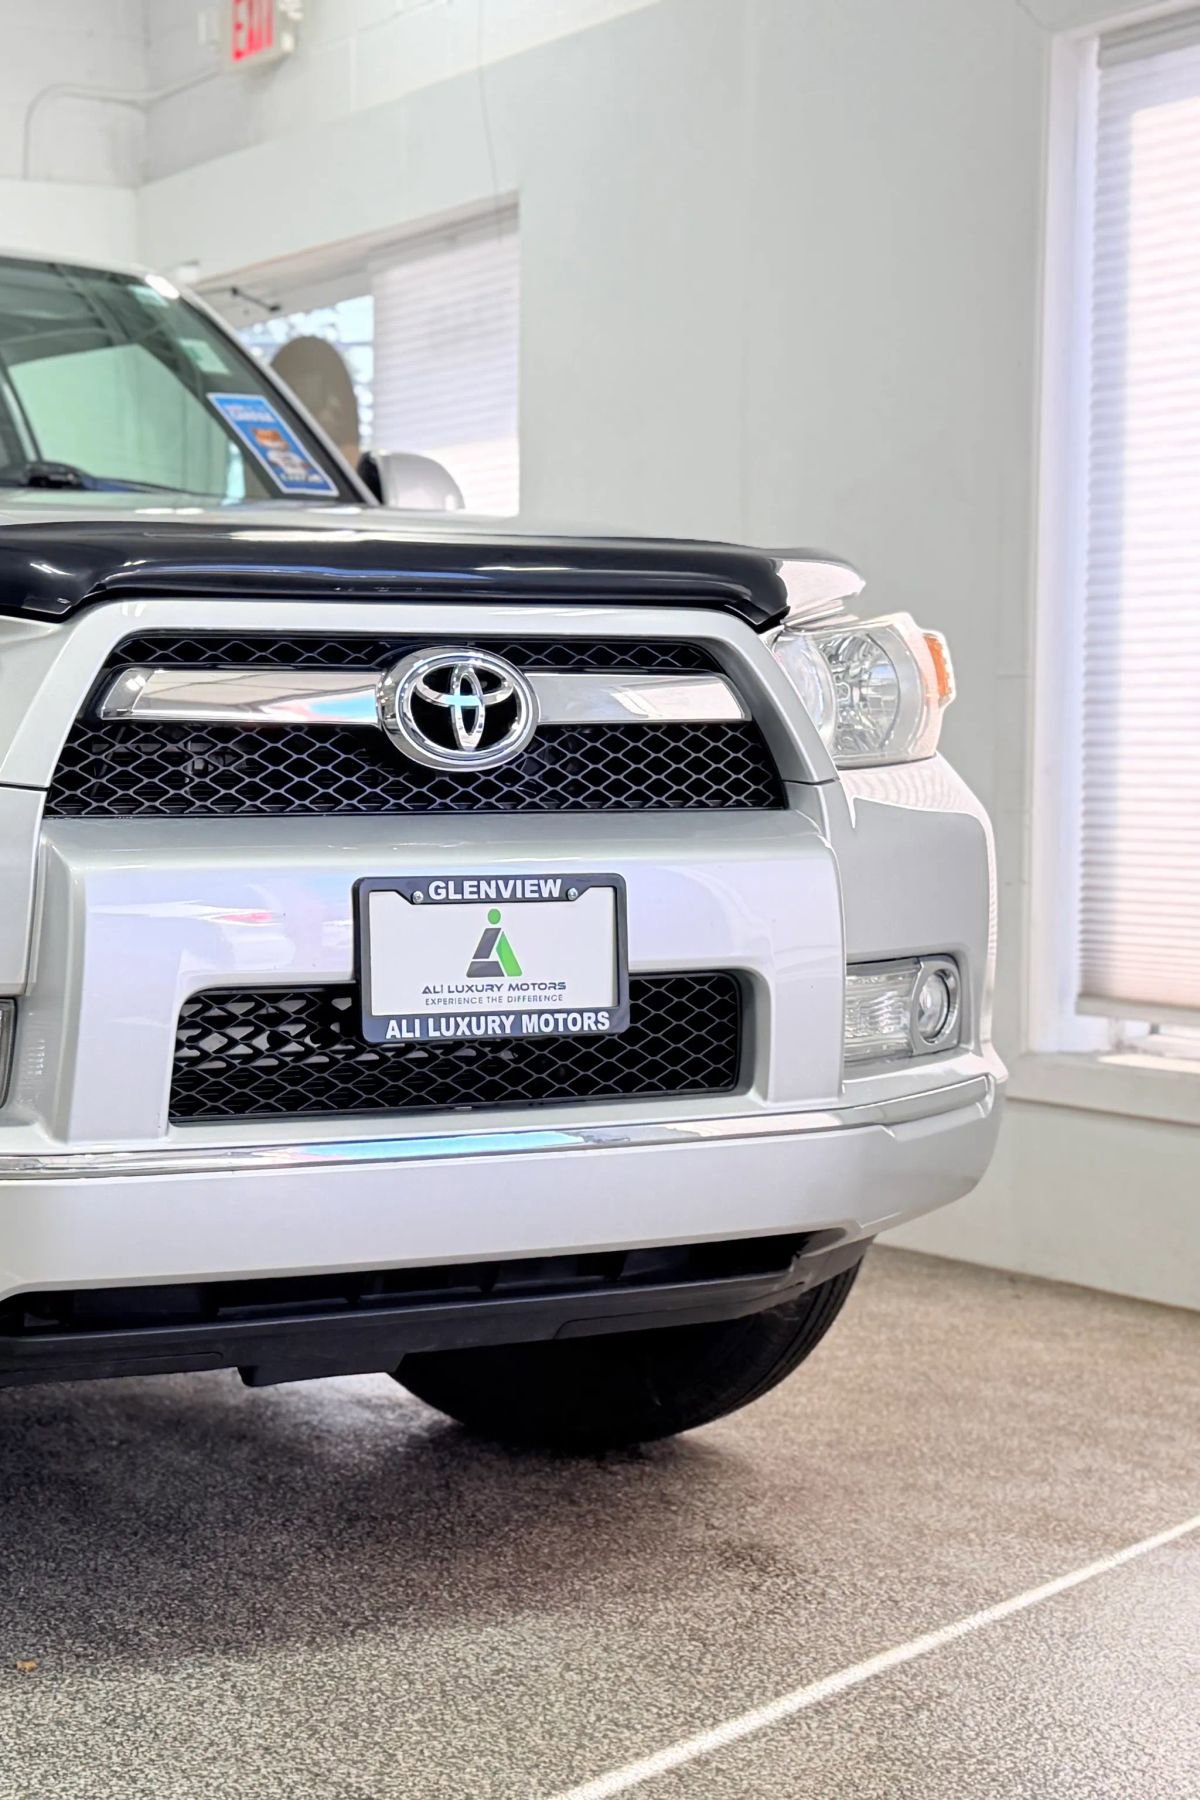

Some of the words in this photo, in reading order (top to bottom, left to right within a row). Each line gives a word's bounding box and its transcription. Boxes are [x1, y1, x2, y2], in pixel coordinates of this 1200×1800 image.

[428, 879, 562, 900] GLENVIEW
[447, 982, 504, 994] LUXURY
[507, 981, 567, 993] MOTORS
[425, 997, 483, 1006] EXPERIENCE
[486, 996, 503, 1004] THE
[507, 994, 564, 1003] DIFFERENCE
[385, 1019, 420, 1039] ALI
[428, 1015, 515, 1036] LUXURY
[522, 1011, 610, 1033] MOTORS
